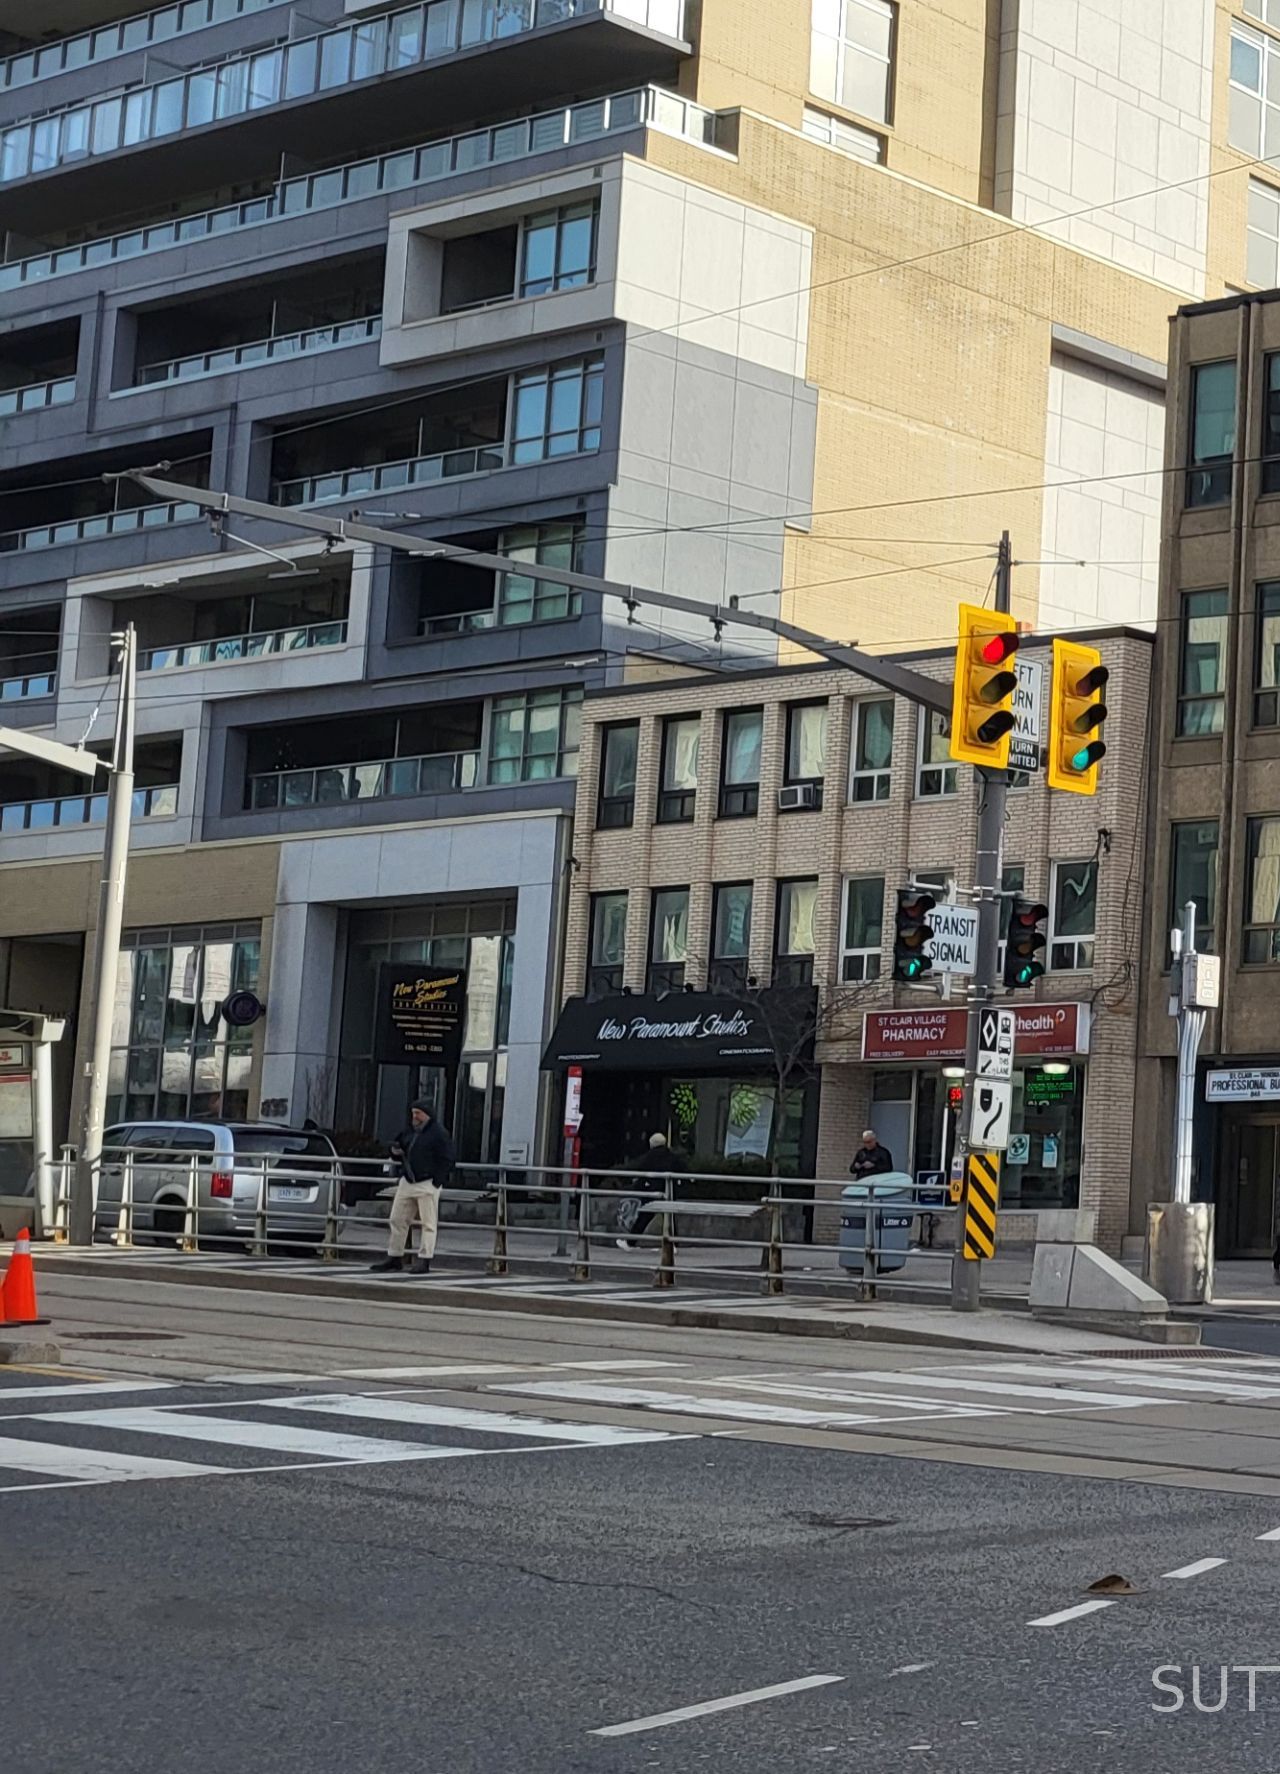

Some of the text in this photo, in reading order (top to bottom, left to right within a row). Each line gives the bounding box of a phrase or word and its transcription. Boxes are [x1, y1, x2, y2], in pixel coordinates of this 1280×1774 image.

[1013, 663, 1033, 685] EFT
[1011, 690, 1033, 710] URN
[1013, 714, 1037, 736] NAL
[927, 913, 976, 938] TRANSIT
[929, 941, 970, 964] SIGNAL
[597, 1009, 753, 1040] New Paramount Studios
[878, 1015, 947, 1026] ST CLAIR VILLAGE
[882, 1027, 946, 1042] PHARMACY
[1211, 1080, 1267, 1092] PROFESSIONAL
